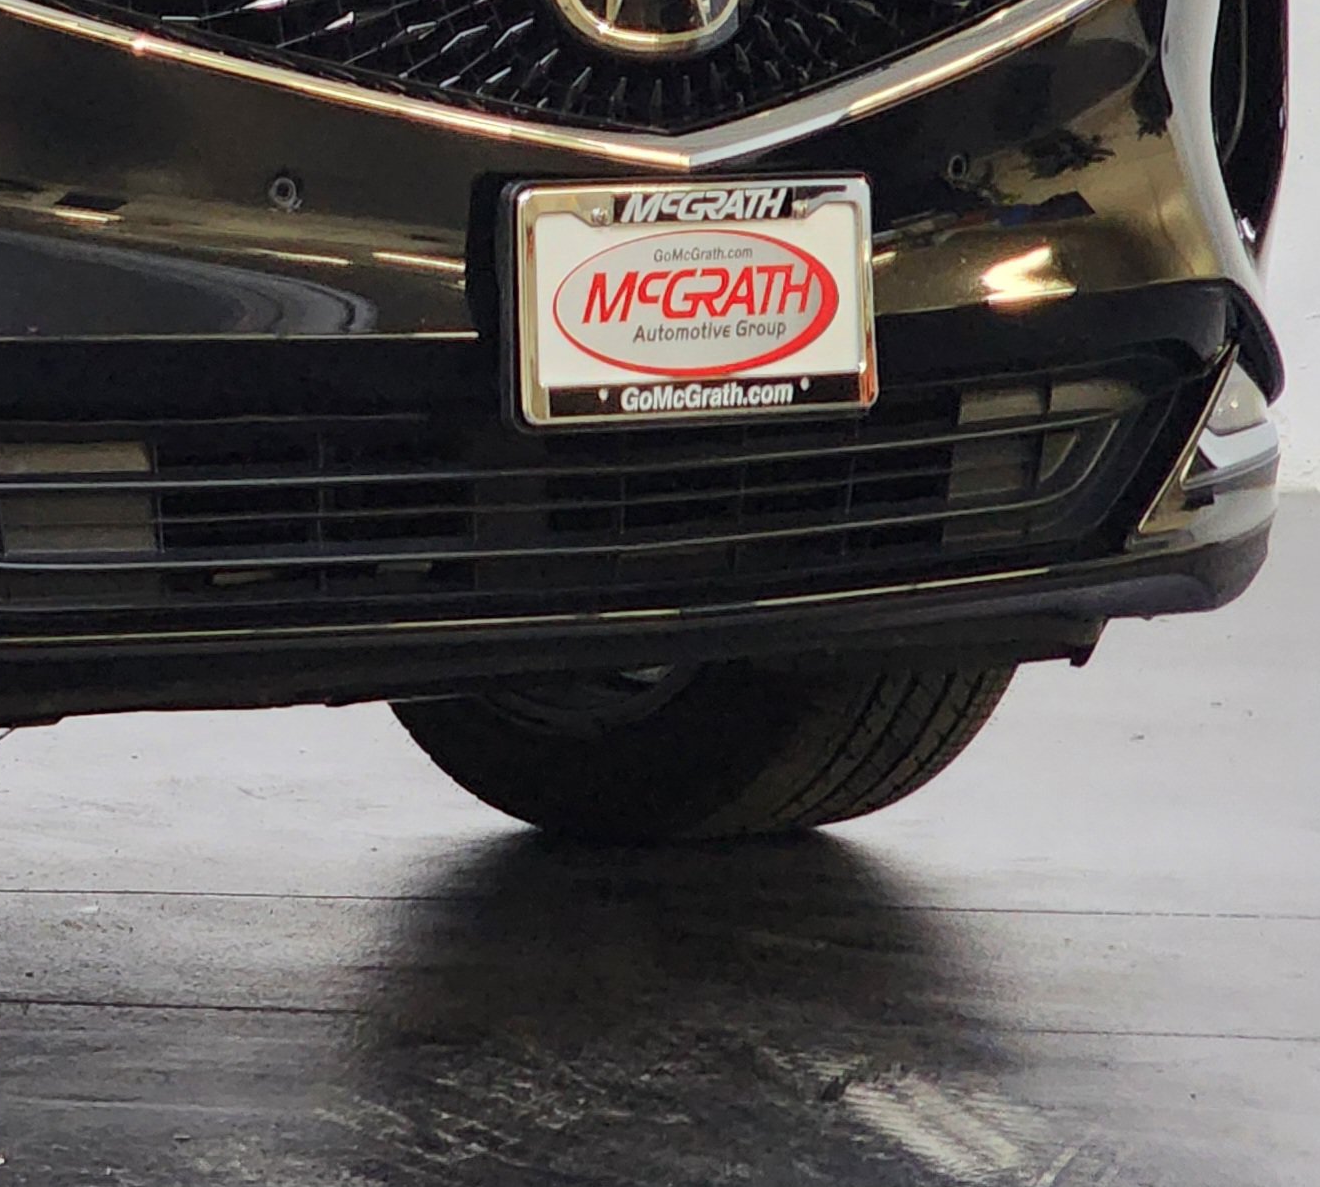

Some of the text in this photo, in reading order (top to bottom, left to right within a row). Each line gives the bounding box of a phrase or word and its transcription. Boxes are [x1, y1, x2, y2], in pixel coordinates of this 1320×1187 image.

[653, 246, 753, 263] GoMcGrath.com
[633, 319, 787, 343] Automotive Group
[620, 381, 794, 412] GoMcGrath.com
